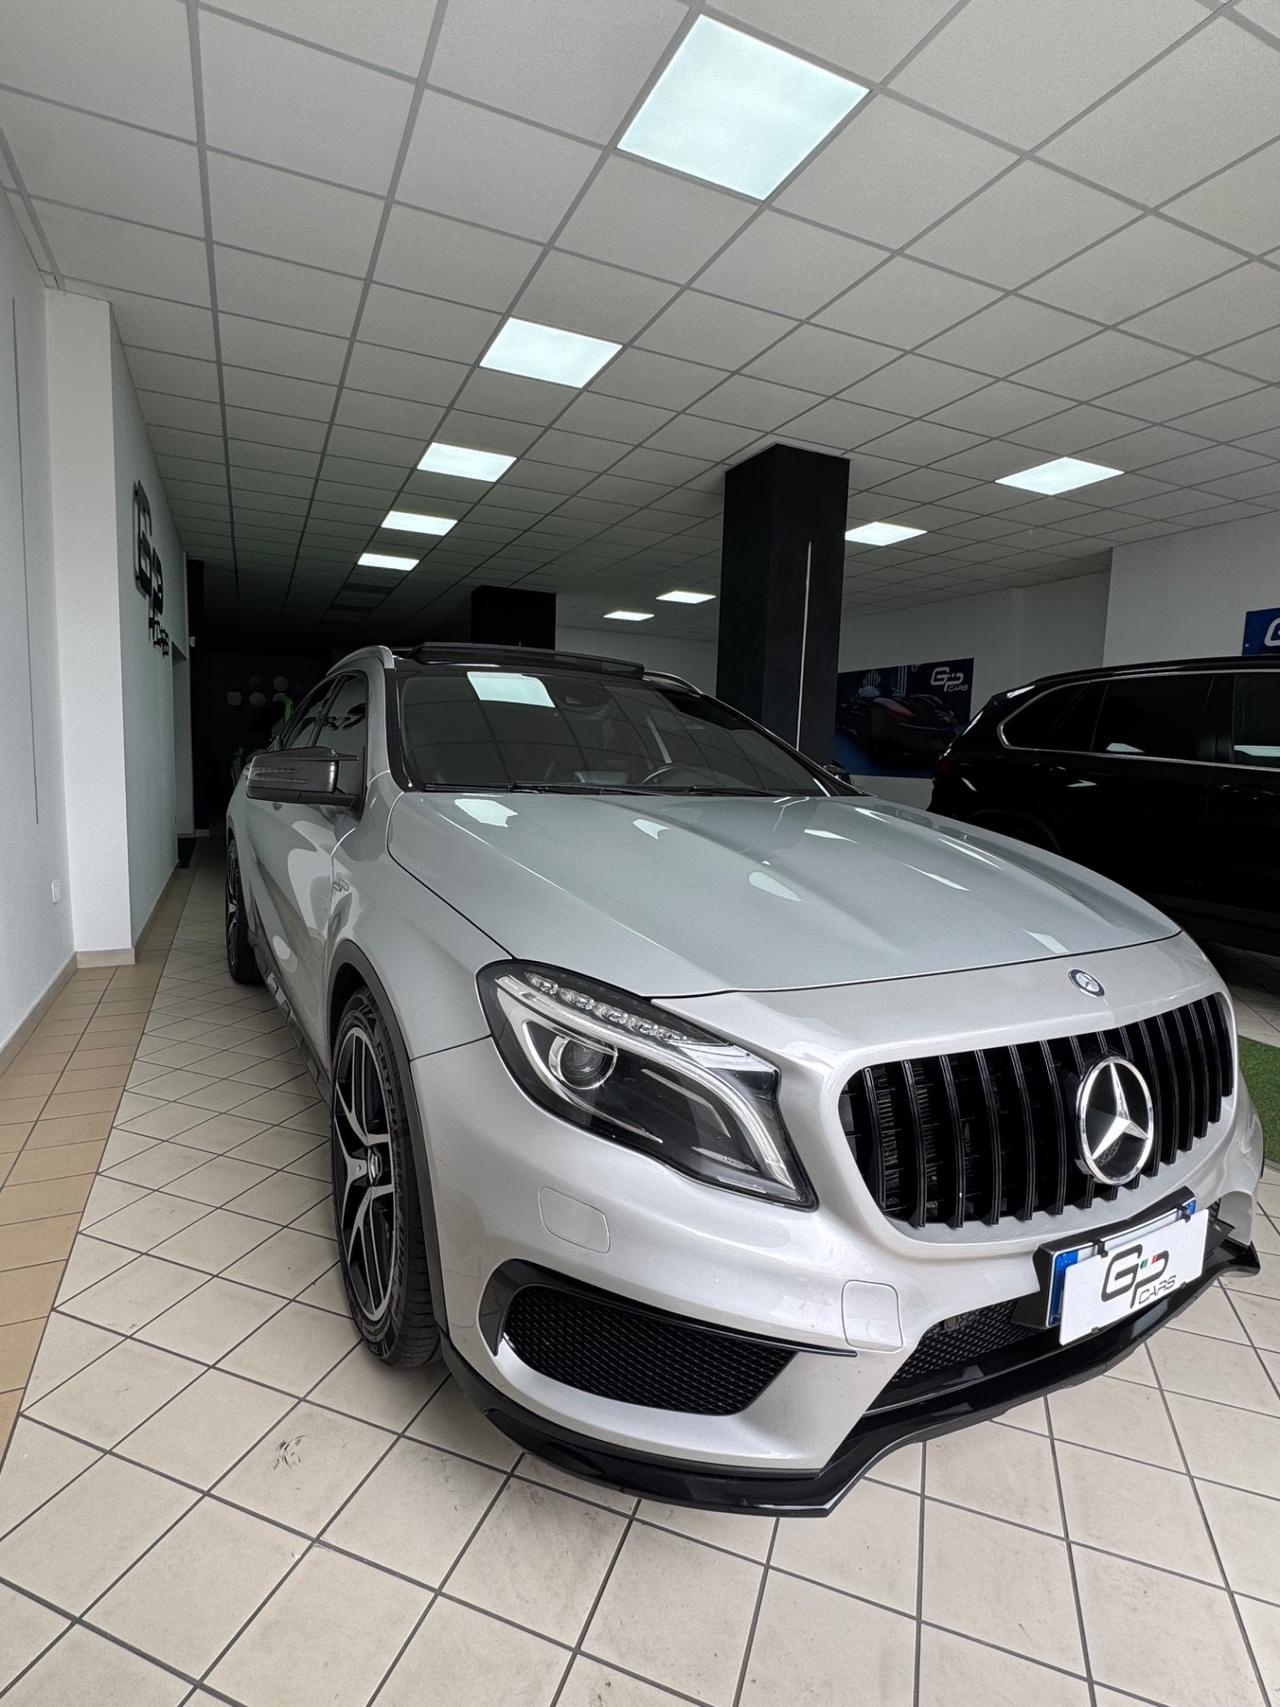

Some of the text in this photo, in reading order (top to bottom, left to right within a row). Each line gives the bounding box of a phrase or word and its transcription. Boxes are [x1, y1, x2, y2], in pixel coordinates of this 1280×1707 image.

[931, 666, 963, 691] GP
[1102, 1244, 1169, 1309] GP
[1139, 1275, 1176, 1304] CARS
